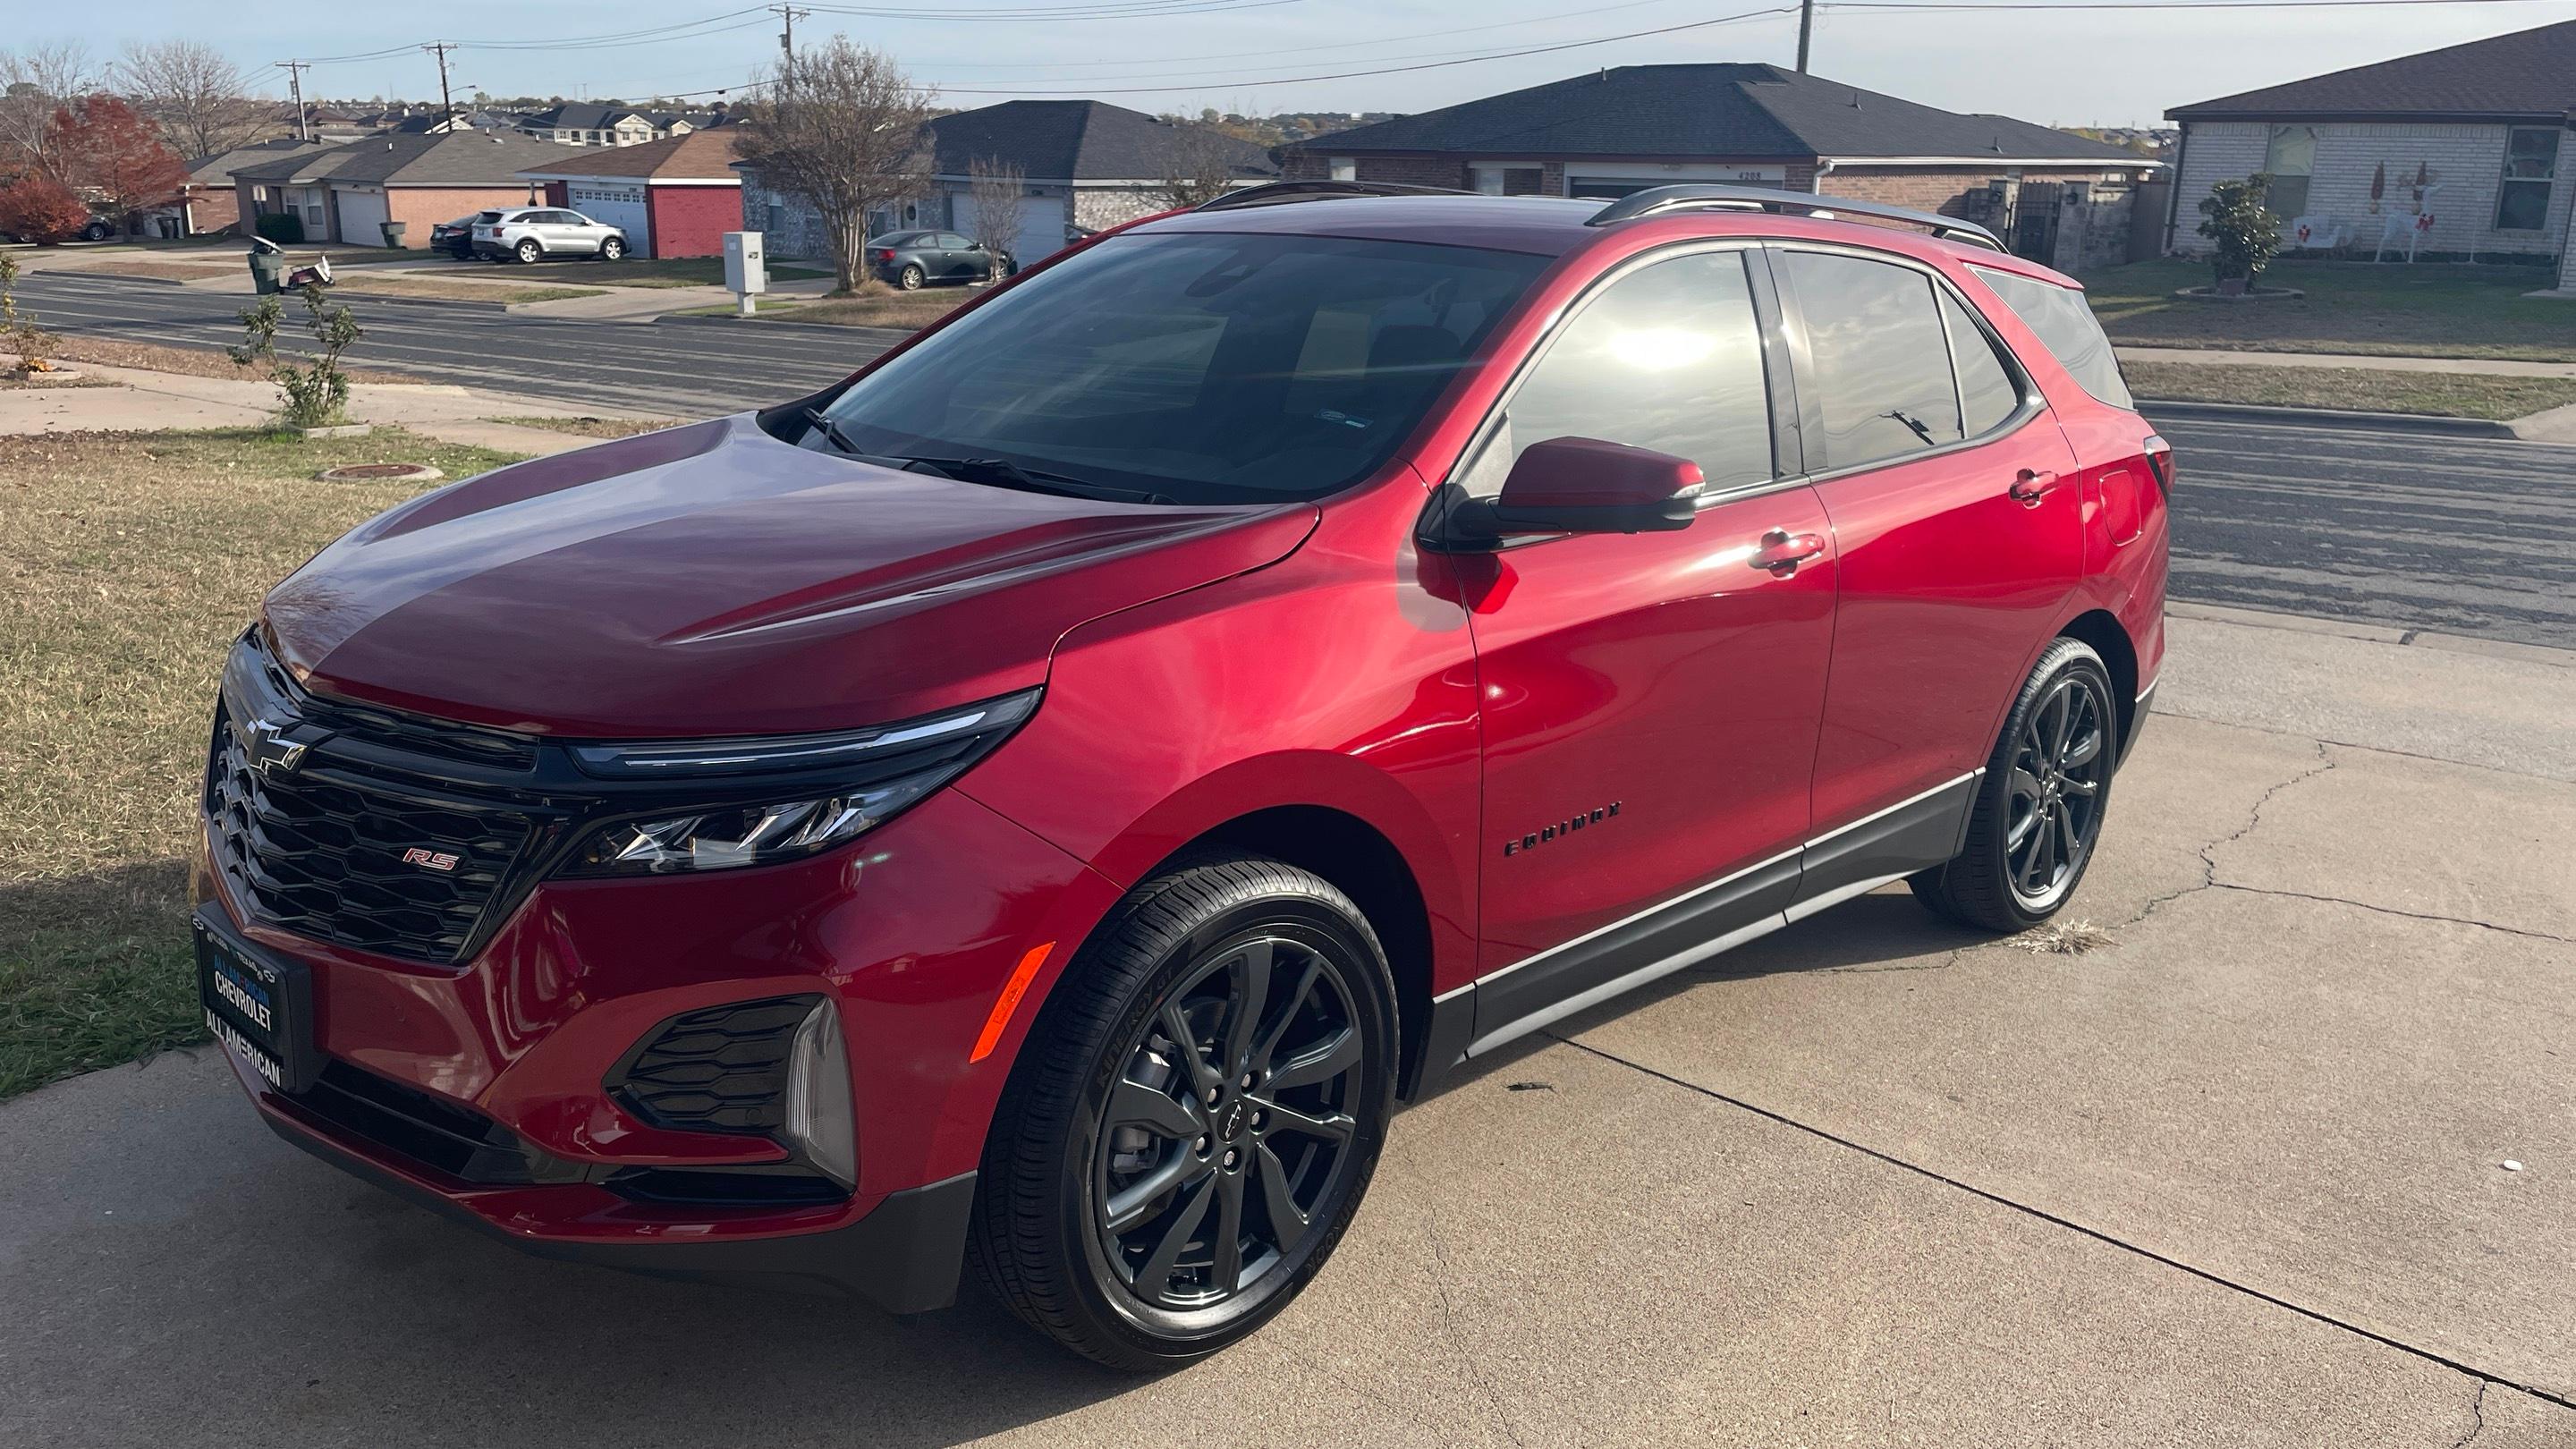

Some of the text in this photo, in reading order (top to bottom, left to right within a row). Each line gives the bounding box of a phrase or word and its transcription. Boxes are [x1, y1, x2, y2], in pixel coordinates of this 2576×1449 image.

[1503, 801, 1622, 857] EQUINOX
[402, 847, 460, 871] RS
[215, 970, 272, 1032] CHEVROLET
[207, 1010, 225, 1039] ALL
[223, 1026, 281, 1088] AMERICAN
